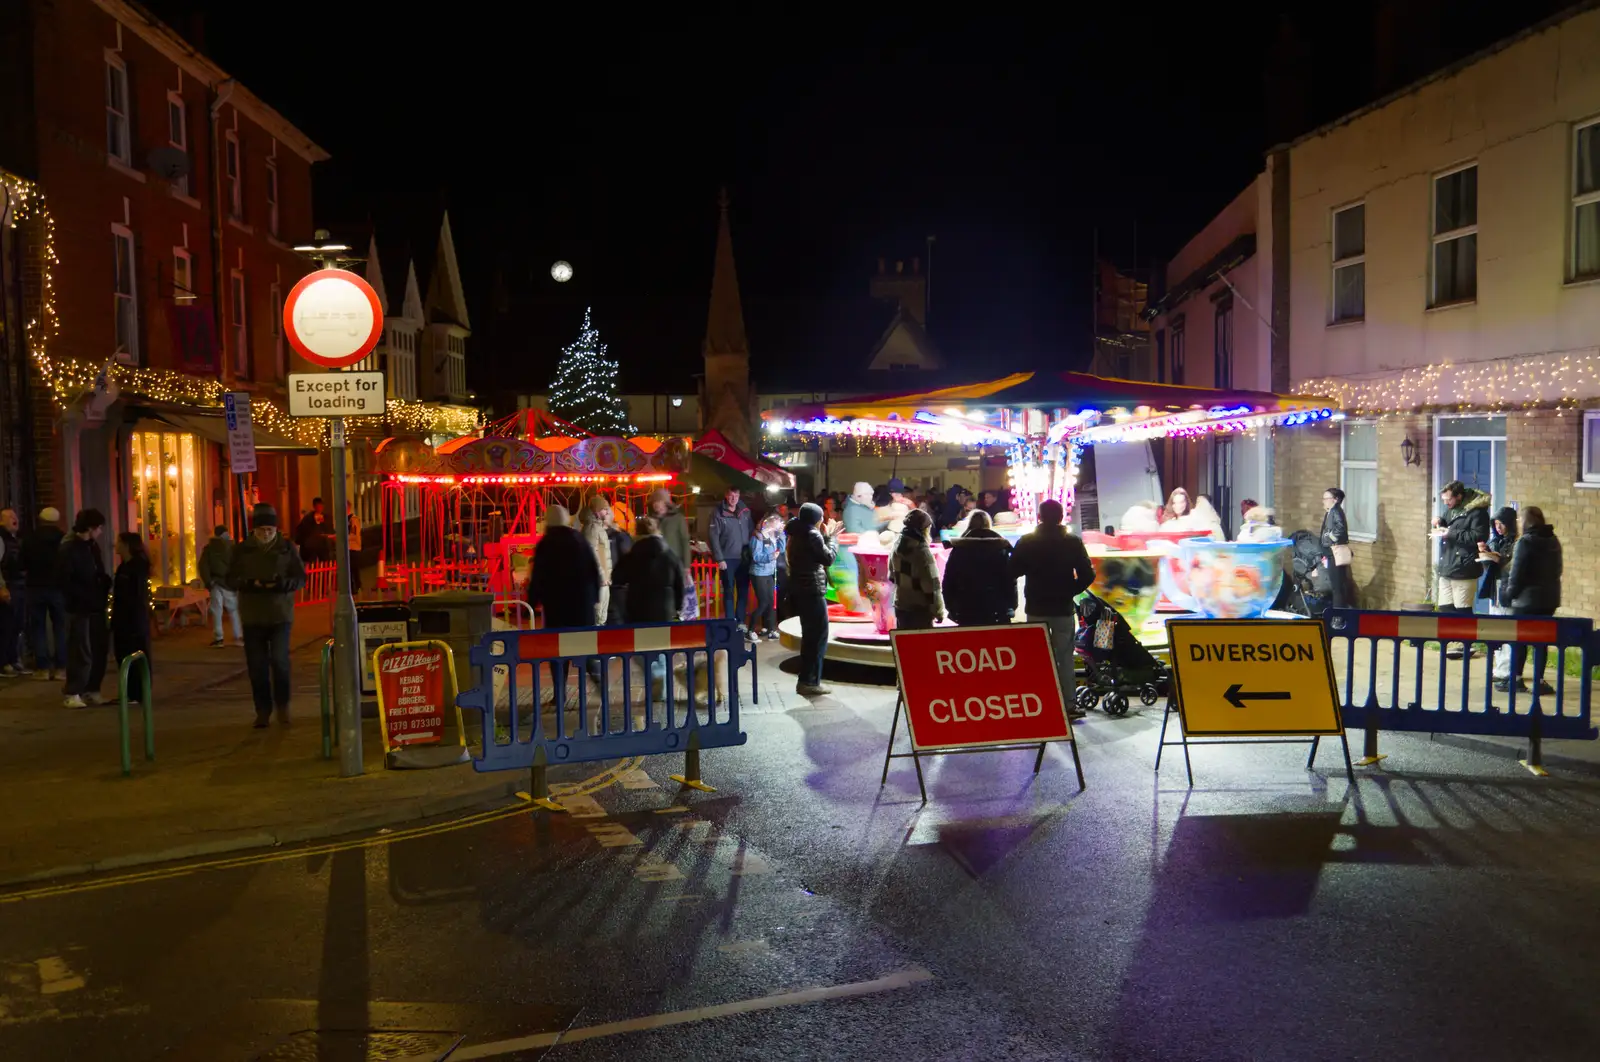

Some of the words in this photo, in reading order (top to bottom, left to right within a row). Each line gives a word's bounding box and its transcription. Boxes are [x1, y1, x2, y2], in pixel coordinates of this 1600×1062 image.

[296, 379, 350, 394] Except
[355, 378, 378, 391] for
[308, 396, 366, 410] loading
[362, 624, 377, 633] THE
[378, 622, 404, 635] VAULT
[1189, 643, 1315, 662] DIVERSION
[383, 654, 414, 670] PIZZA
[936, 646, 1017, 674] ROAD
[400, 675, 424, 684] KEBABS
[403, 686, 420, 694] PIZZA
[398, 696, 426, 705] BURGERS
[389, 707, 407, 717] FRIED
[408, 704, 435, 715] CHICKEN
[928, 693, 1043, 723] CLOSED
[411, 717, 441, 728] 873300
